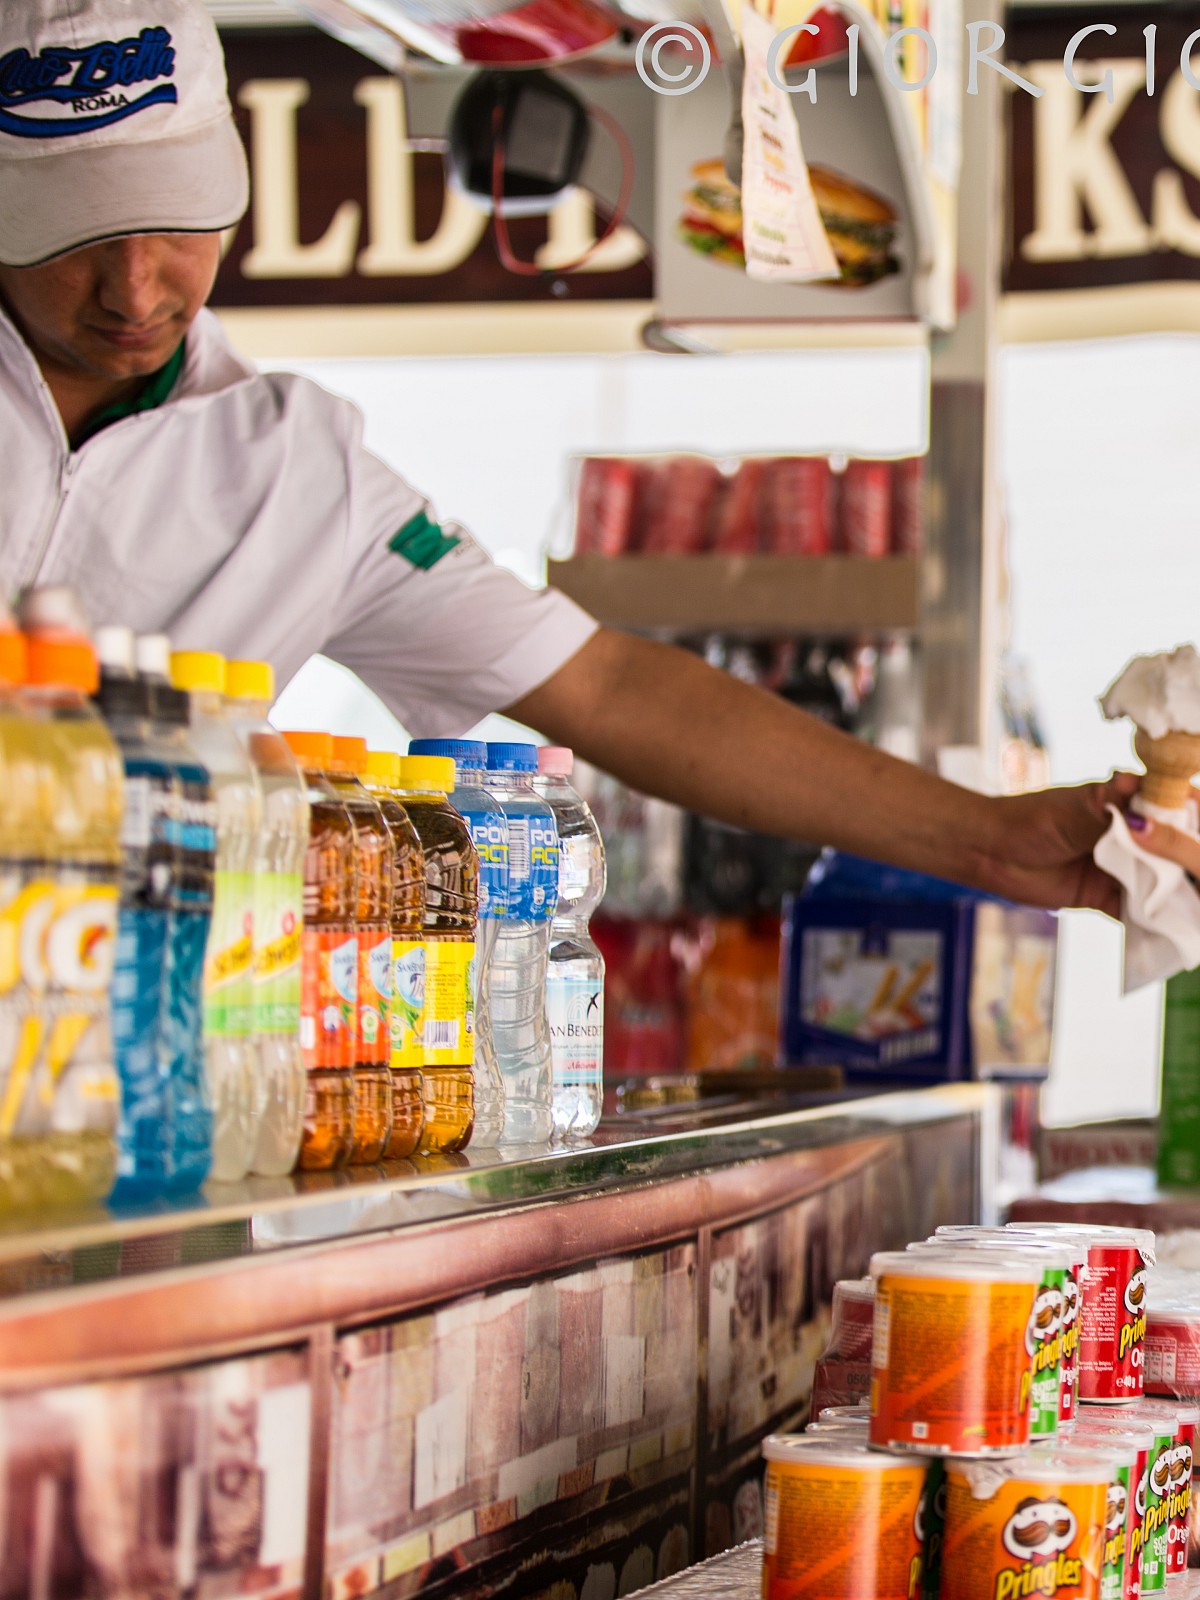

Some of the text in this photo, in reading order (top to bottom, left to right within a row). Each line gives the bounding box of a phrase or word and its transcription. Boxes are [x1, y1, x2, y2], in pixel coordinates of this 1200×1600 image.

[72, 94, 130, 113] ROMA
[228, 76, 496, 279] LD
[996, 1551, 1082, 1600] Pringles
